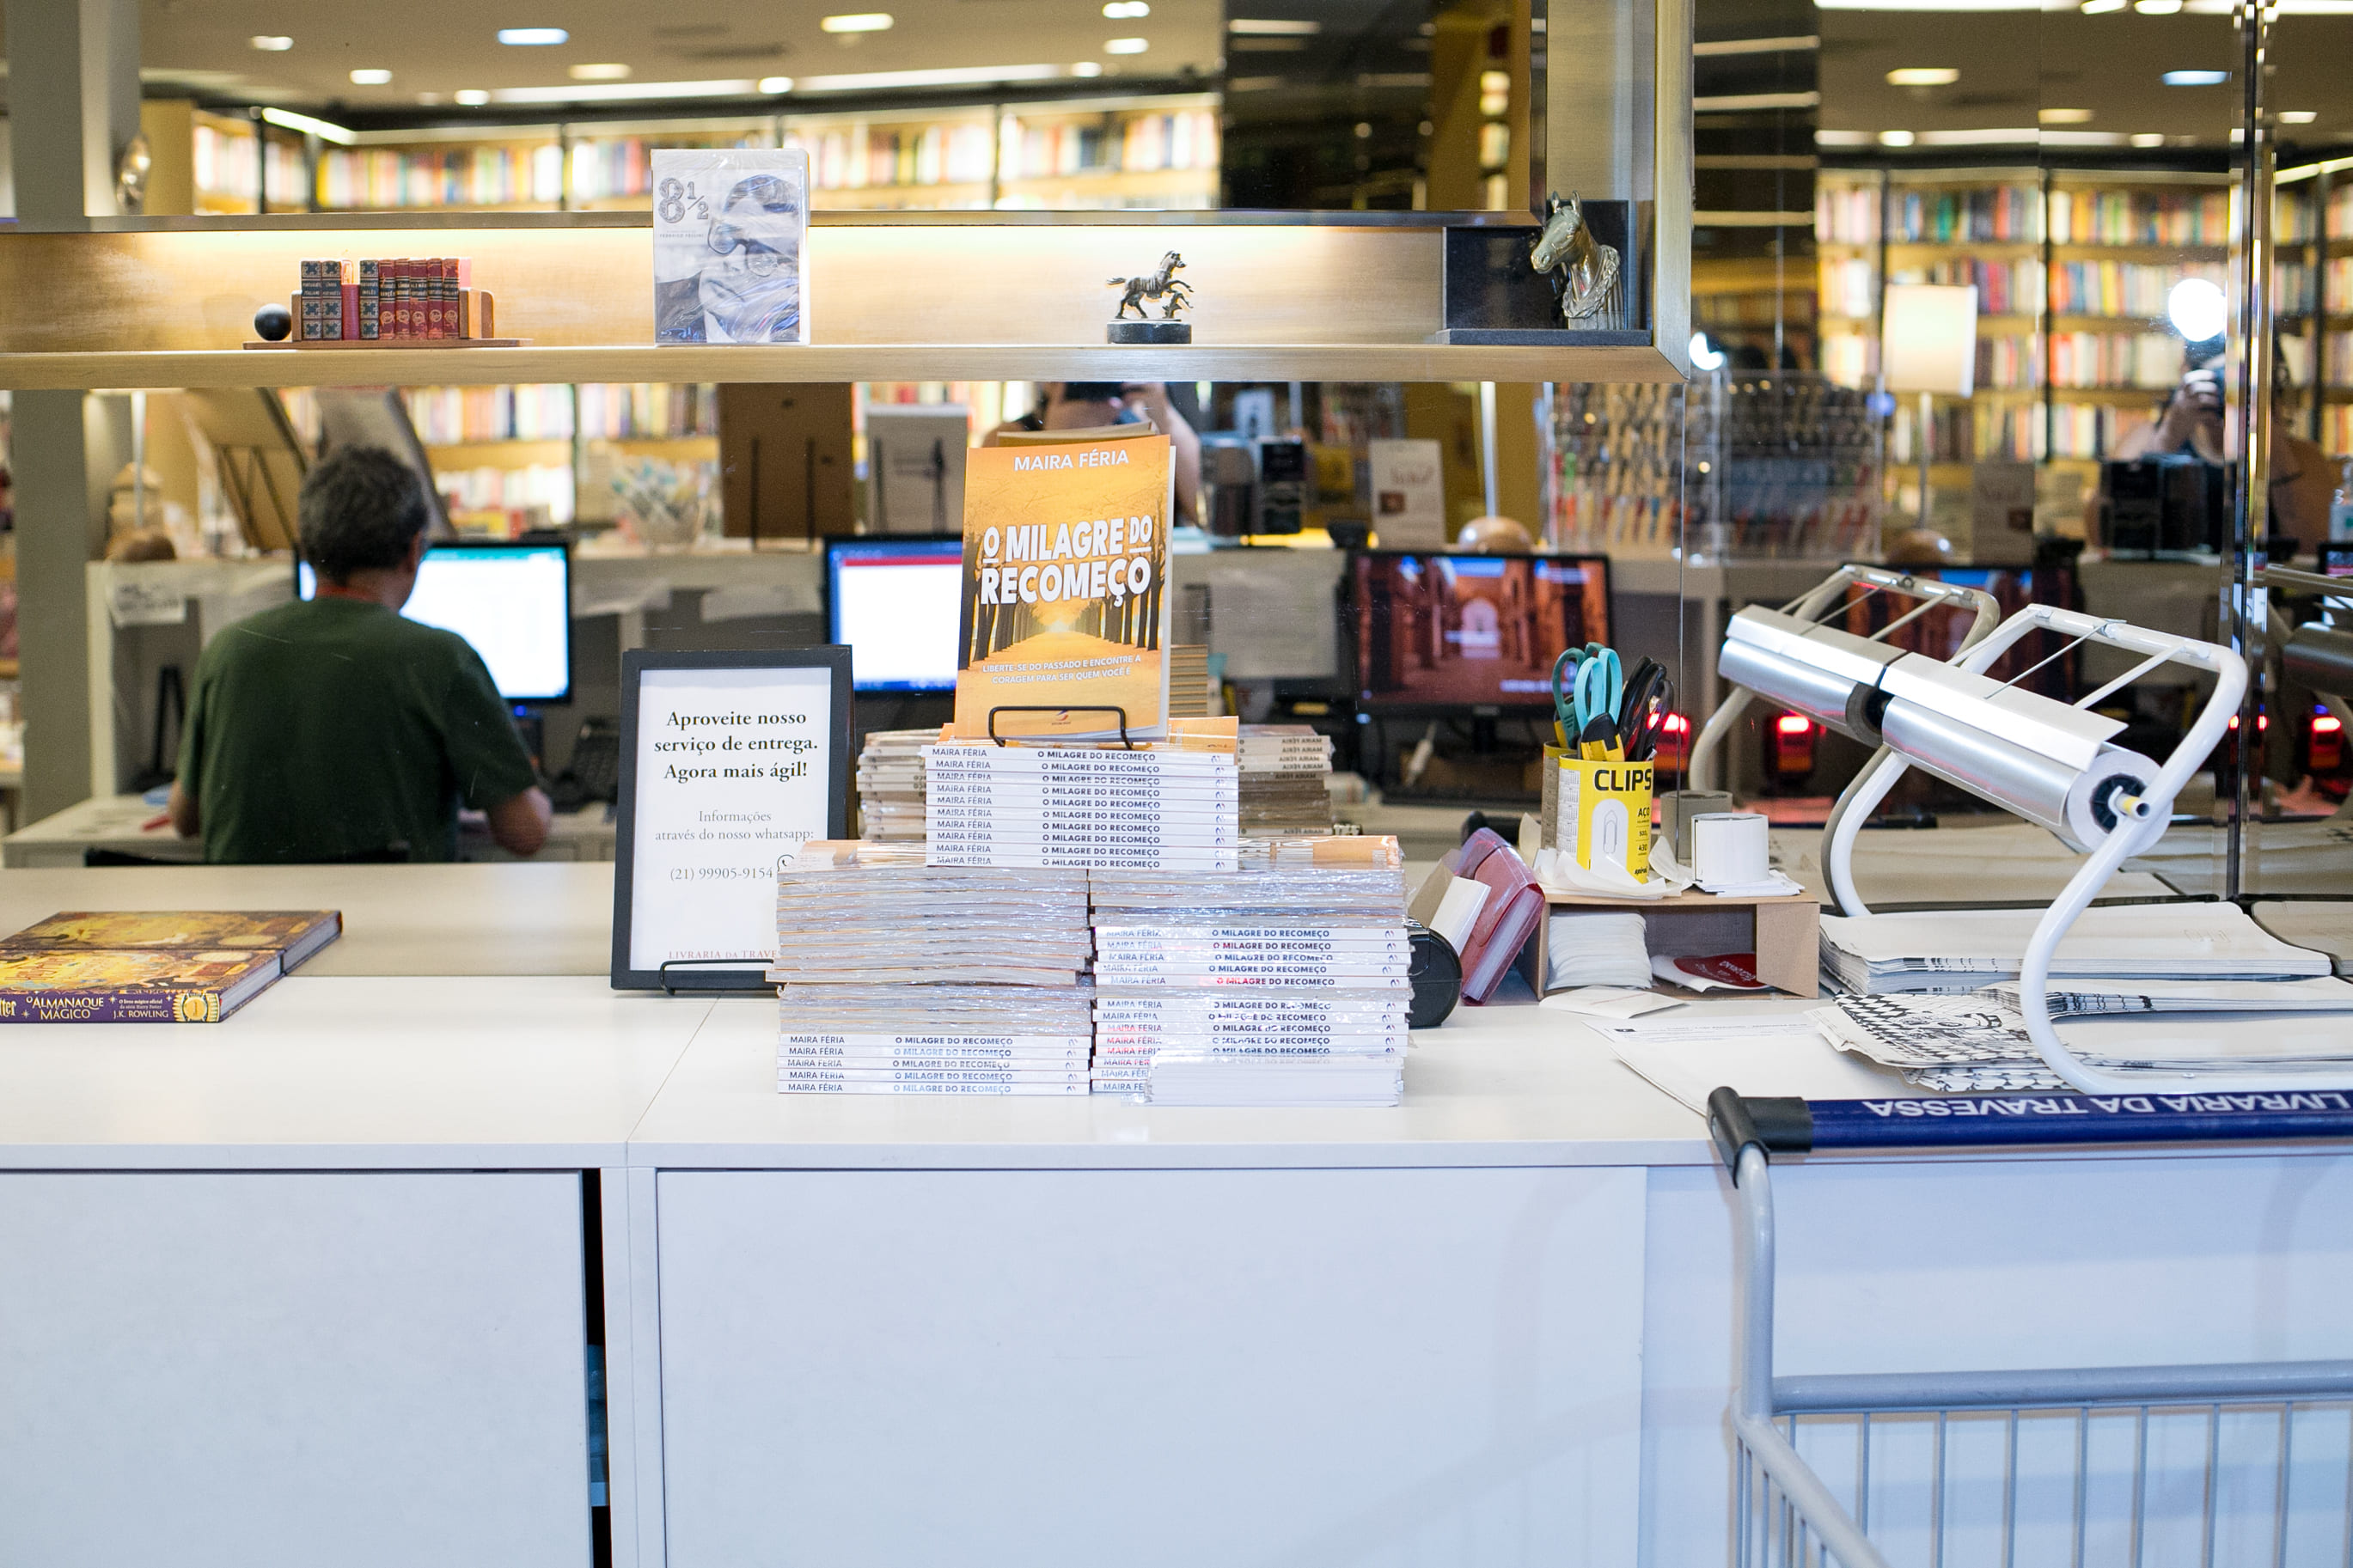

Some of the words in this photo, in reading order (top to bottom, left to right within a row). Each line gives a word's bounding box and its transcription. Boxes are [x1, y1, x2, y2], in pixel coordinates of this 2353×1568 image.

[1015, 455, 1073, 471] MAIRA
[1079, 448, 1128, 467] FÉRIA
[983, 527, 1000, 558] O
[1005, 518, 1124, 562] MILAGRE
[1129, 515, 1152, 544] DO
[981, 557, 1151, 607] RECOMEÇO
[982, 663, 1027, 672] LIBERTE-SE
[1044, 661, 1080, 669] PASSADO
[1090, 656, 1133, 667] ENCONTRE
[992, 675, 1033, 684] CORAGEM
[1076, 671, 1099, 680] QUEM
[1102, 666, 1123, 676] VOCÊ
[1125, 667, 1130, 675] É
[667, 711, 751, 730] Aproveite
[758, 713, 806, 724] nosso
[654, 737, 716, 755] serviço
[722, 735, 743, 750] de
[749, 738, 817, 754] entrega.
[963, 747, 987, 757] FÉRIA
[1105, 753, 1156, 761] RECOMEÇO
[664, 764, 717, 784] Agora
[724, 764, 763, 778] mais
[770, 761, 807, 782] ágil!
[967, 760, 991, 769] FÉRIA
[1109, 765, 1159, 773] RECOMEÇO
[1594, 768, 1652, 791] CLIPS
[937, 784, 965, 793] MAIRA
[968, 784, 992, 794] FÉRIA
[1110, 790, 1160, 798] RECOMEÇO
[938, 796, 965, 805] MAIRA
[969, 796, 992, 805] FÉRIA
[1110, 801, 1160, 809] RECOMEÇO
[699, 809, 772, 824] Informações
[938, 808, 965, 817] MAIRA
[969, 808, 992, 817] FÉRIA
[938, 821, 965, 829] MAIRA
[969, 821, 992, 829] FÉRIA
[1110, 825, 1160, 833] RECOMEÇO
[656, 829, 694, 840] através
[699, 828, 713, 839] do
[718, 831, 750, 839] nosso
[755, 828, 814, 842] whatsapp:
[969, 832, 992, 841] FÉRIA
[1110, 836, 1160, 845] RECOMEÇO
[968, 844, 991, 853] FÉRIA
[1109, 849, 1160, 857] RECOMEÇO
[670, 868, 694, 881] (21)
[699, 867, 773, 880] 99905-9154
[1280, 930, 1329, 939] RECOMEÇO
[1280, 943, 1331, 951] RECOMEÇO
[669, 950, 721, 959] LIVRARIA
[1277, 966, 1327, 974] RECOMEÇO
[33, 997, 104, 1010] ALMANAQUE
[40, 1008, 90, 1020] MÁGICO
[113, 1010, 125, 1019] J.K.
[821, 1034, 845, 1044] FÉRIA
[963, 1037, 1013, 1047] RECOMEÇO
[819, 1046, 844, 1055] FÉRIA
[962, 1049, 1011, 1059] RECOMEÇO
[818, 1082, 843, 1091] FÉRIA
[945, 1084, 958, 1093] DO
[961, 1085, 1011, 1095] RECOMEÇO
[1861, 1098, 2089, 1117] TRAVESSA
[2088, 1097, 2156, 1113] DA
[2157, 1093, 2352, 1112] LIVRARIA
